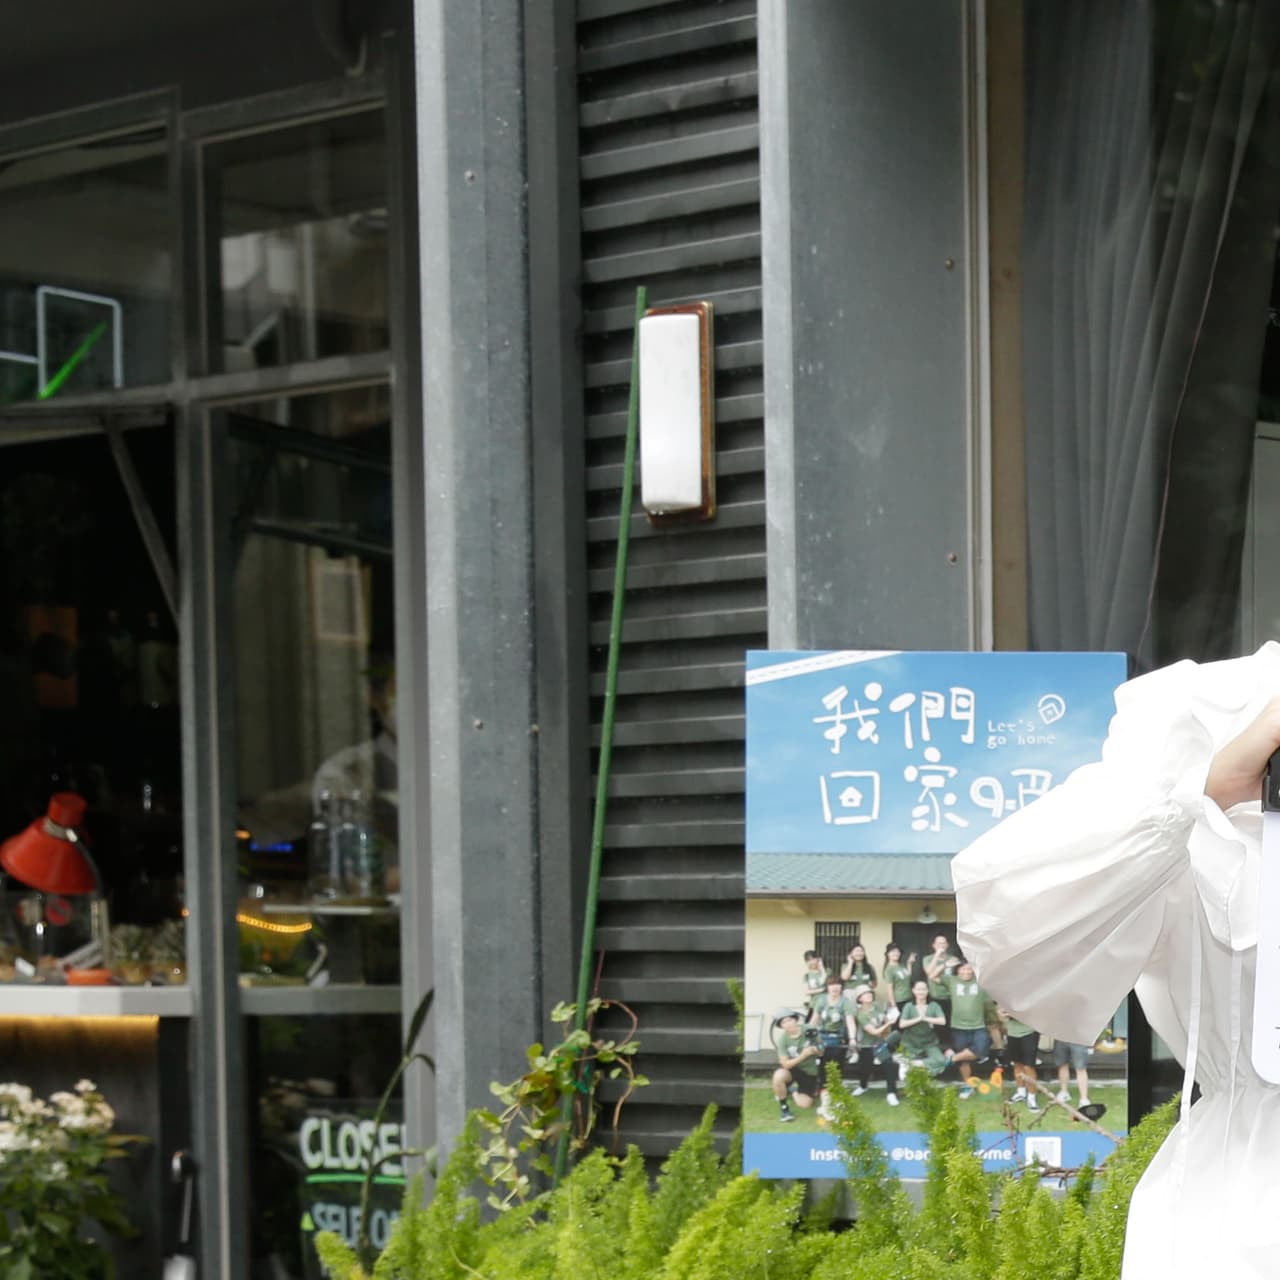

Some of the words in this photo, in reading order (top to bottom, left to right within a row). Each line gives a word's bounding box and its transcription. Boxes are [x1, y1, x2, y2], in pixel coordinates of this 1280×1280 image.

[811, 682, 976, 755] 我們
[987, 719, 1035, 733] Let's
[986, 735, 1007, 750] go
[1017, 735, 1057, 745] home
[301, 1117, 407, 1175] CLOSE
